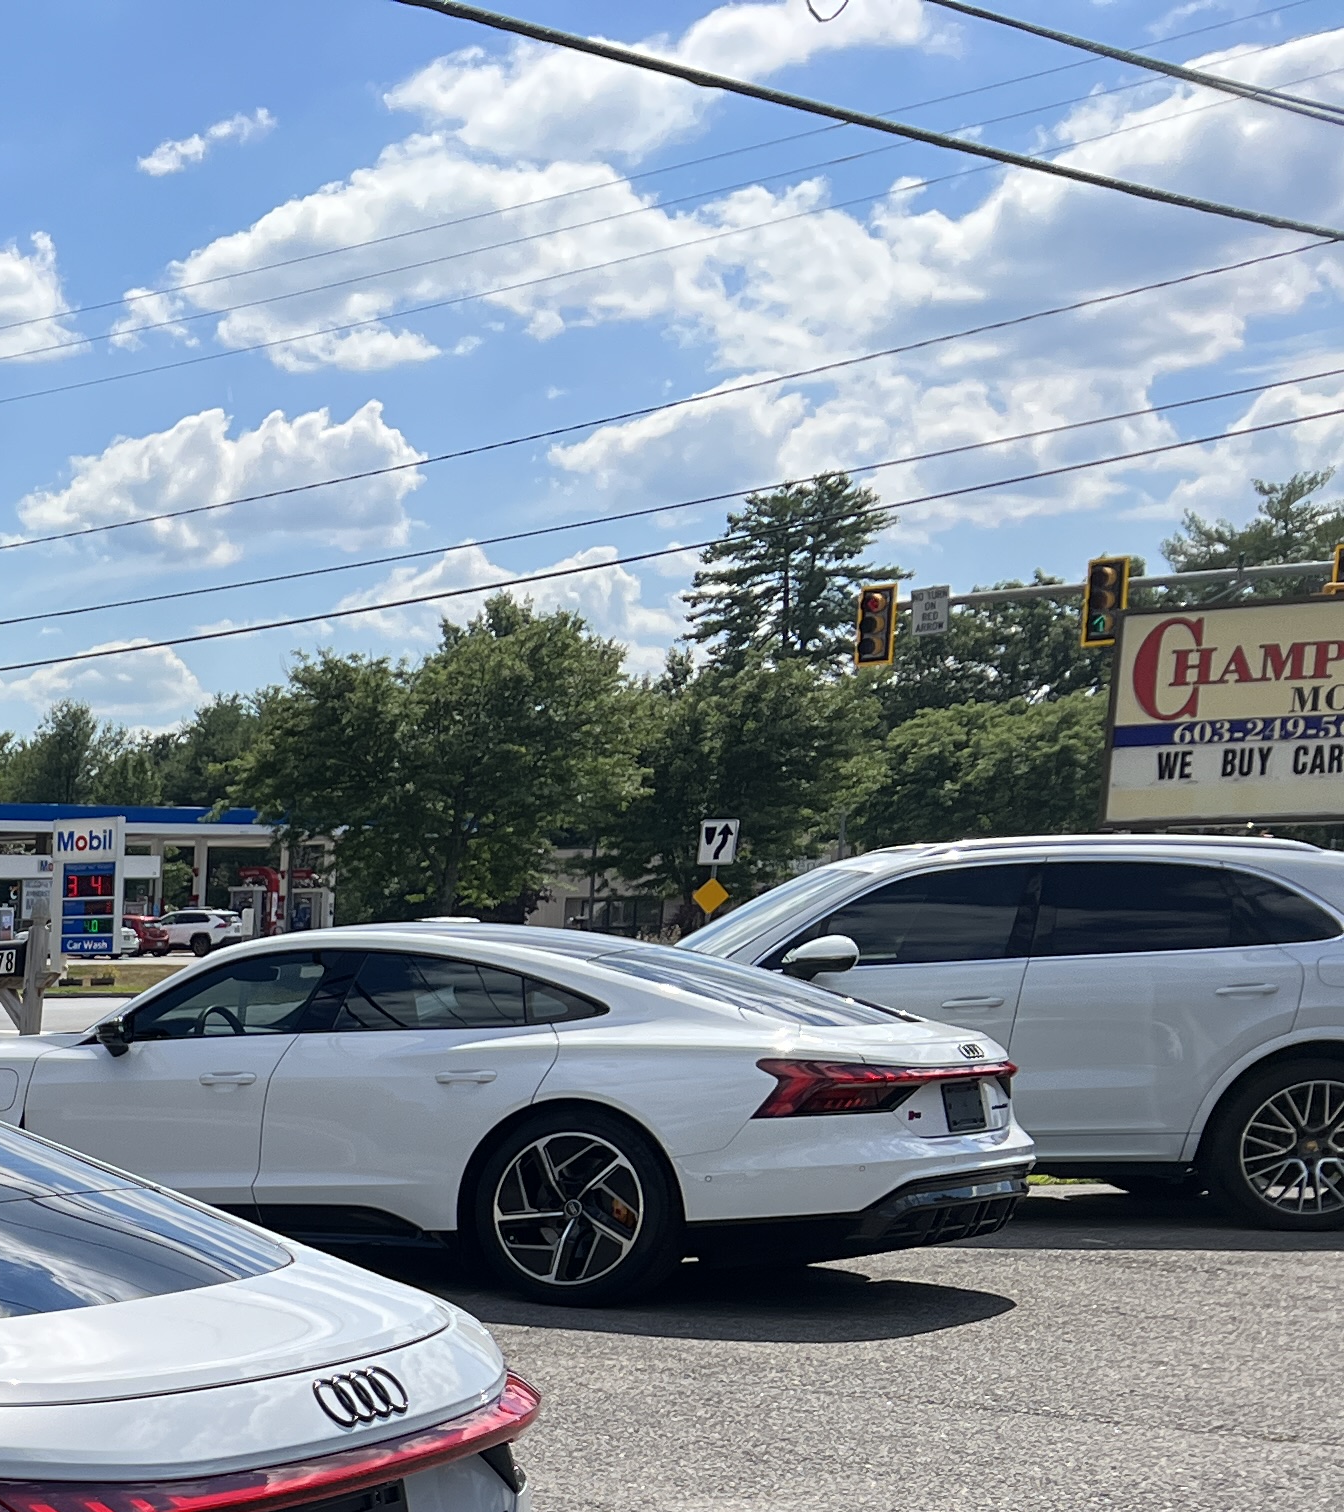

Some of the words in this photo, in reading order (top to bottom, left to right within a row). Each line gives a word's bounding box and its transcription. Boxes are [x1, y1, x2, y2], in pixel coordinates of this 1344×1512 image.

[912, 592, 924, 601] NO
[927, 590, 948, 600] TURN
[924, 601, 937, 611] ON
[922, 611, 939, 621] RED
[915, 621, 944, 632] ARROW
[1172, 715, 1344, 746] 603-249-5
[1157, 750, 1193, 781] WE
[1221, 746, 1273, 778] BUY
[1292, 744, 1344, 775] CAR
[57, 828, 113, 852] Mobil
[66, 939, 82, 951] Car
[83, 939, 108, 951] Wash
